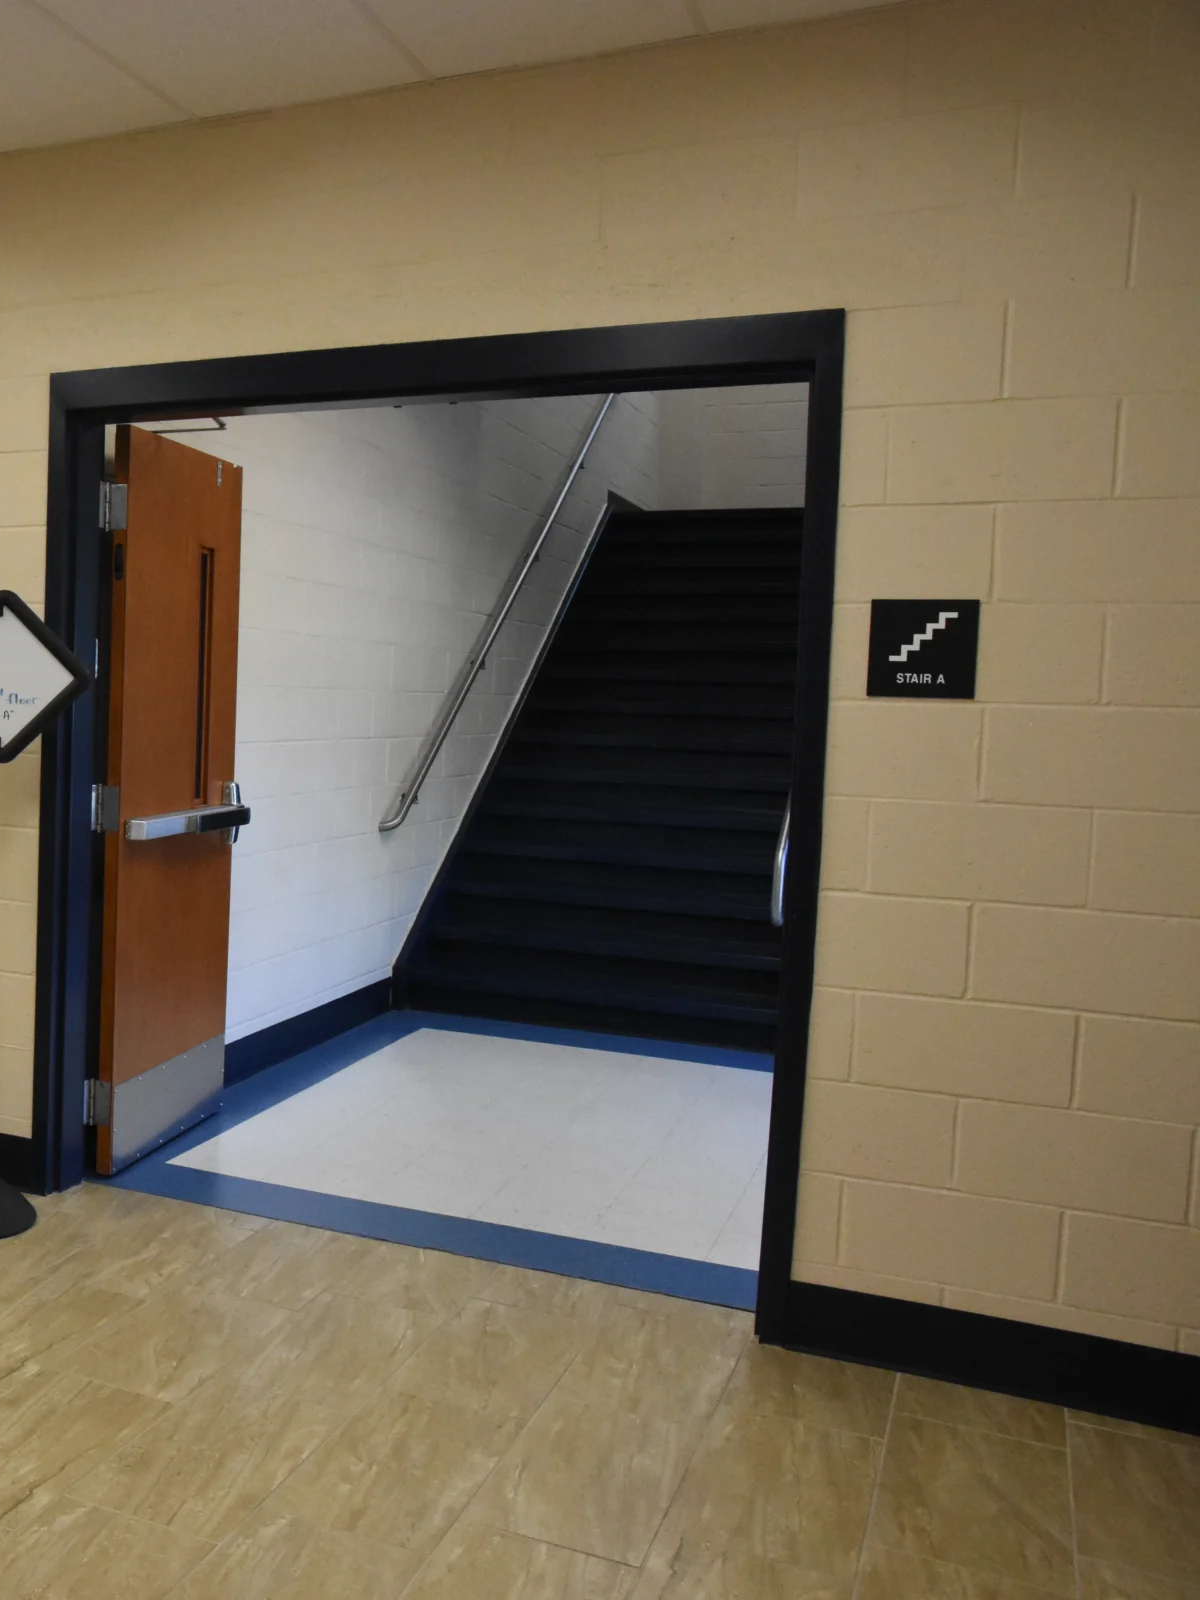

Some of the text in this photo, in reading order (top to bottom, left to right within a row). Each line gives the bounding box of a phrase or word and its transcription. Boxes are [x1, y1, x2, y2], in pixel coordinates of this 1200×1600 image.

[896, 673, 945, 684] STAIR A
[6, 693, 39, 705] floor
